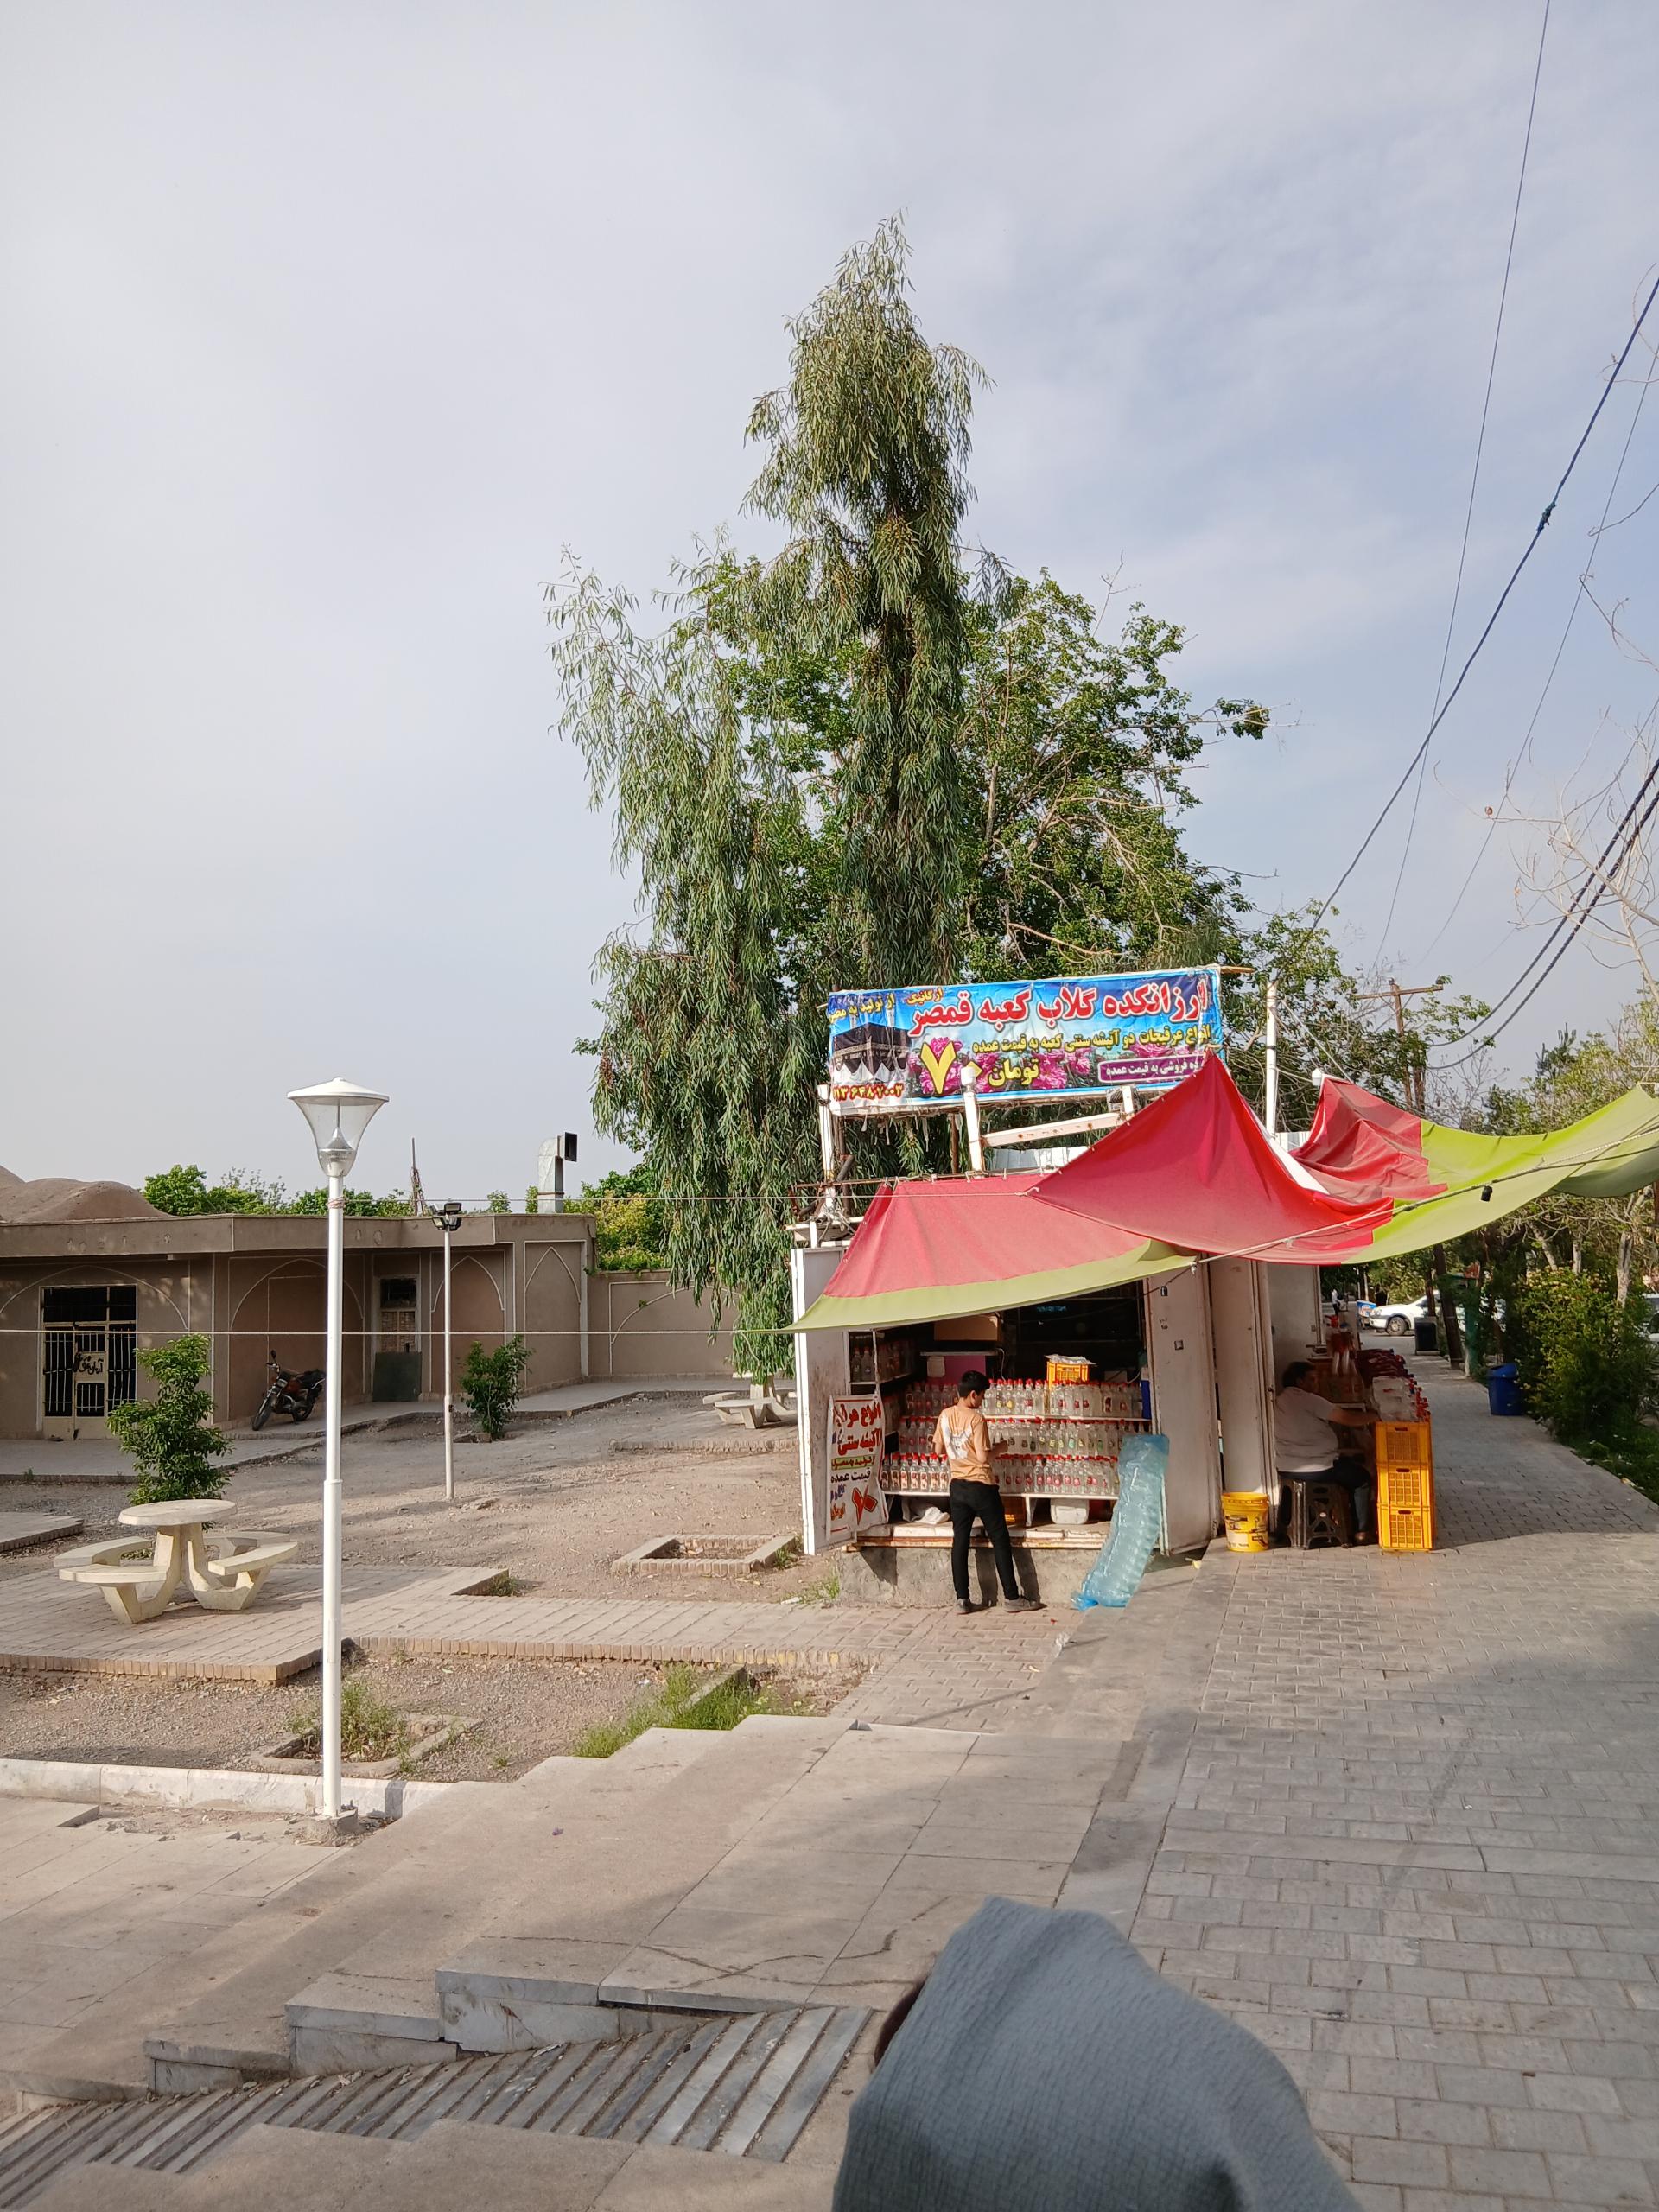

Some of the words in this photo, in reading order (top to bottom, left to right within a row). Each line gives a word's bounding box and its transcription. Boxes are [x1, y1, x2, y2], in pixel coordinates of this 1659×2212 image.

[859, 995, 883, 1014] تولید
[885, 993, 895, 1010] از
[1037, 986, 1097, 1028] گلاب
[1103, 979, 1208, 1022] ارزانکده
[829, 1008, 847, 1024] مصر
[908, 990, 973, 1036] قمصر
[977, 988, 1032, 1031] کعبه
[972, 1039, 999, 1053] عمده
[1001, 1033, 1027, 1052] قیمت
[1028, 1037, 1039, 1051] به
[1040, 1033, 1064, 1052] کعبه
[1065, 1034, 1090, 1052] سنتی
[1123, 1033, 1135, 1049] دو
[988, 1058, 1039, 1087] تومان
[1106, 1064, 1127, 1077] عمده
[1128, 1061, 1149, 1077] قیمت
[1149, 1064, 1159, 1074] به
[1160, 1058, 1188, 1076] فروشی
[830, 1472, 849, 1484] عمده
[851, 1466, 871, 1483] قیمت
